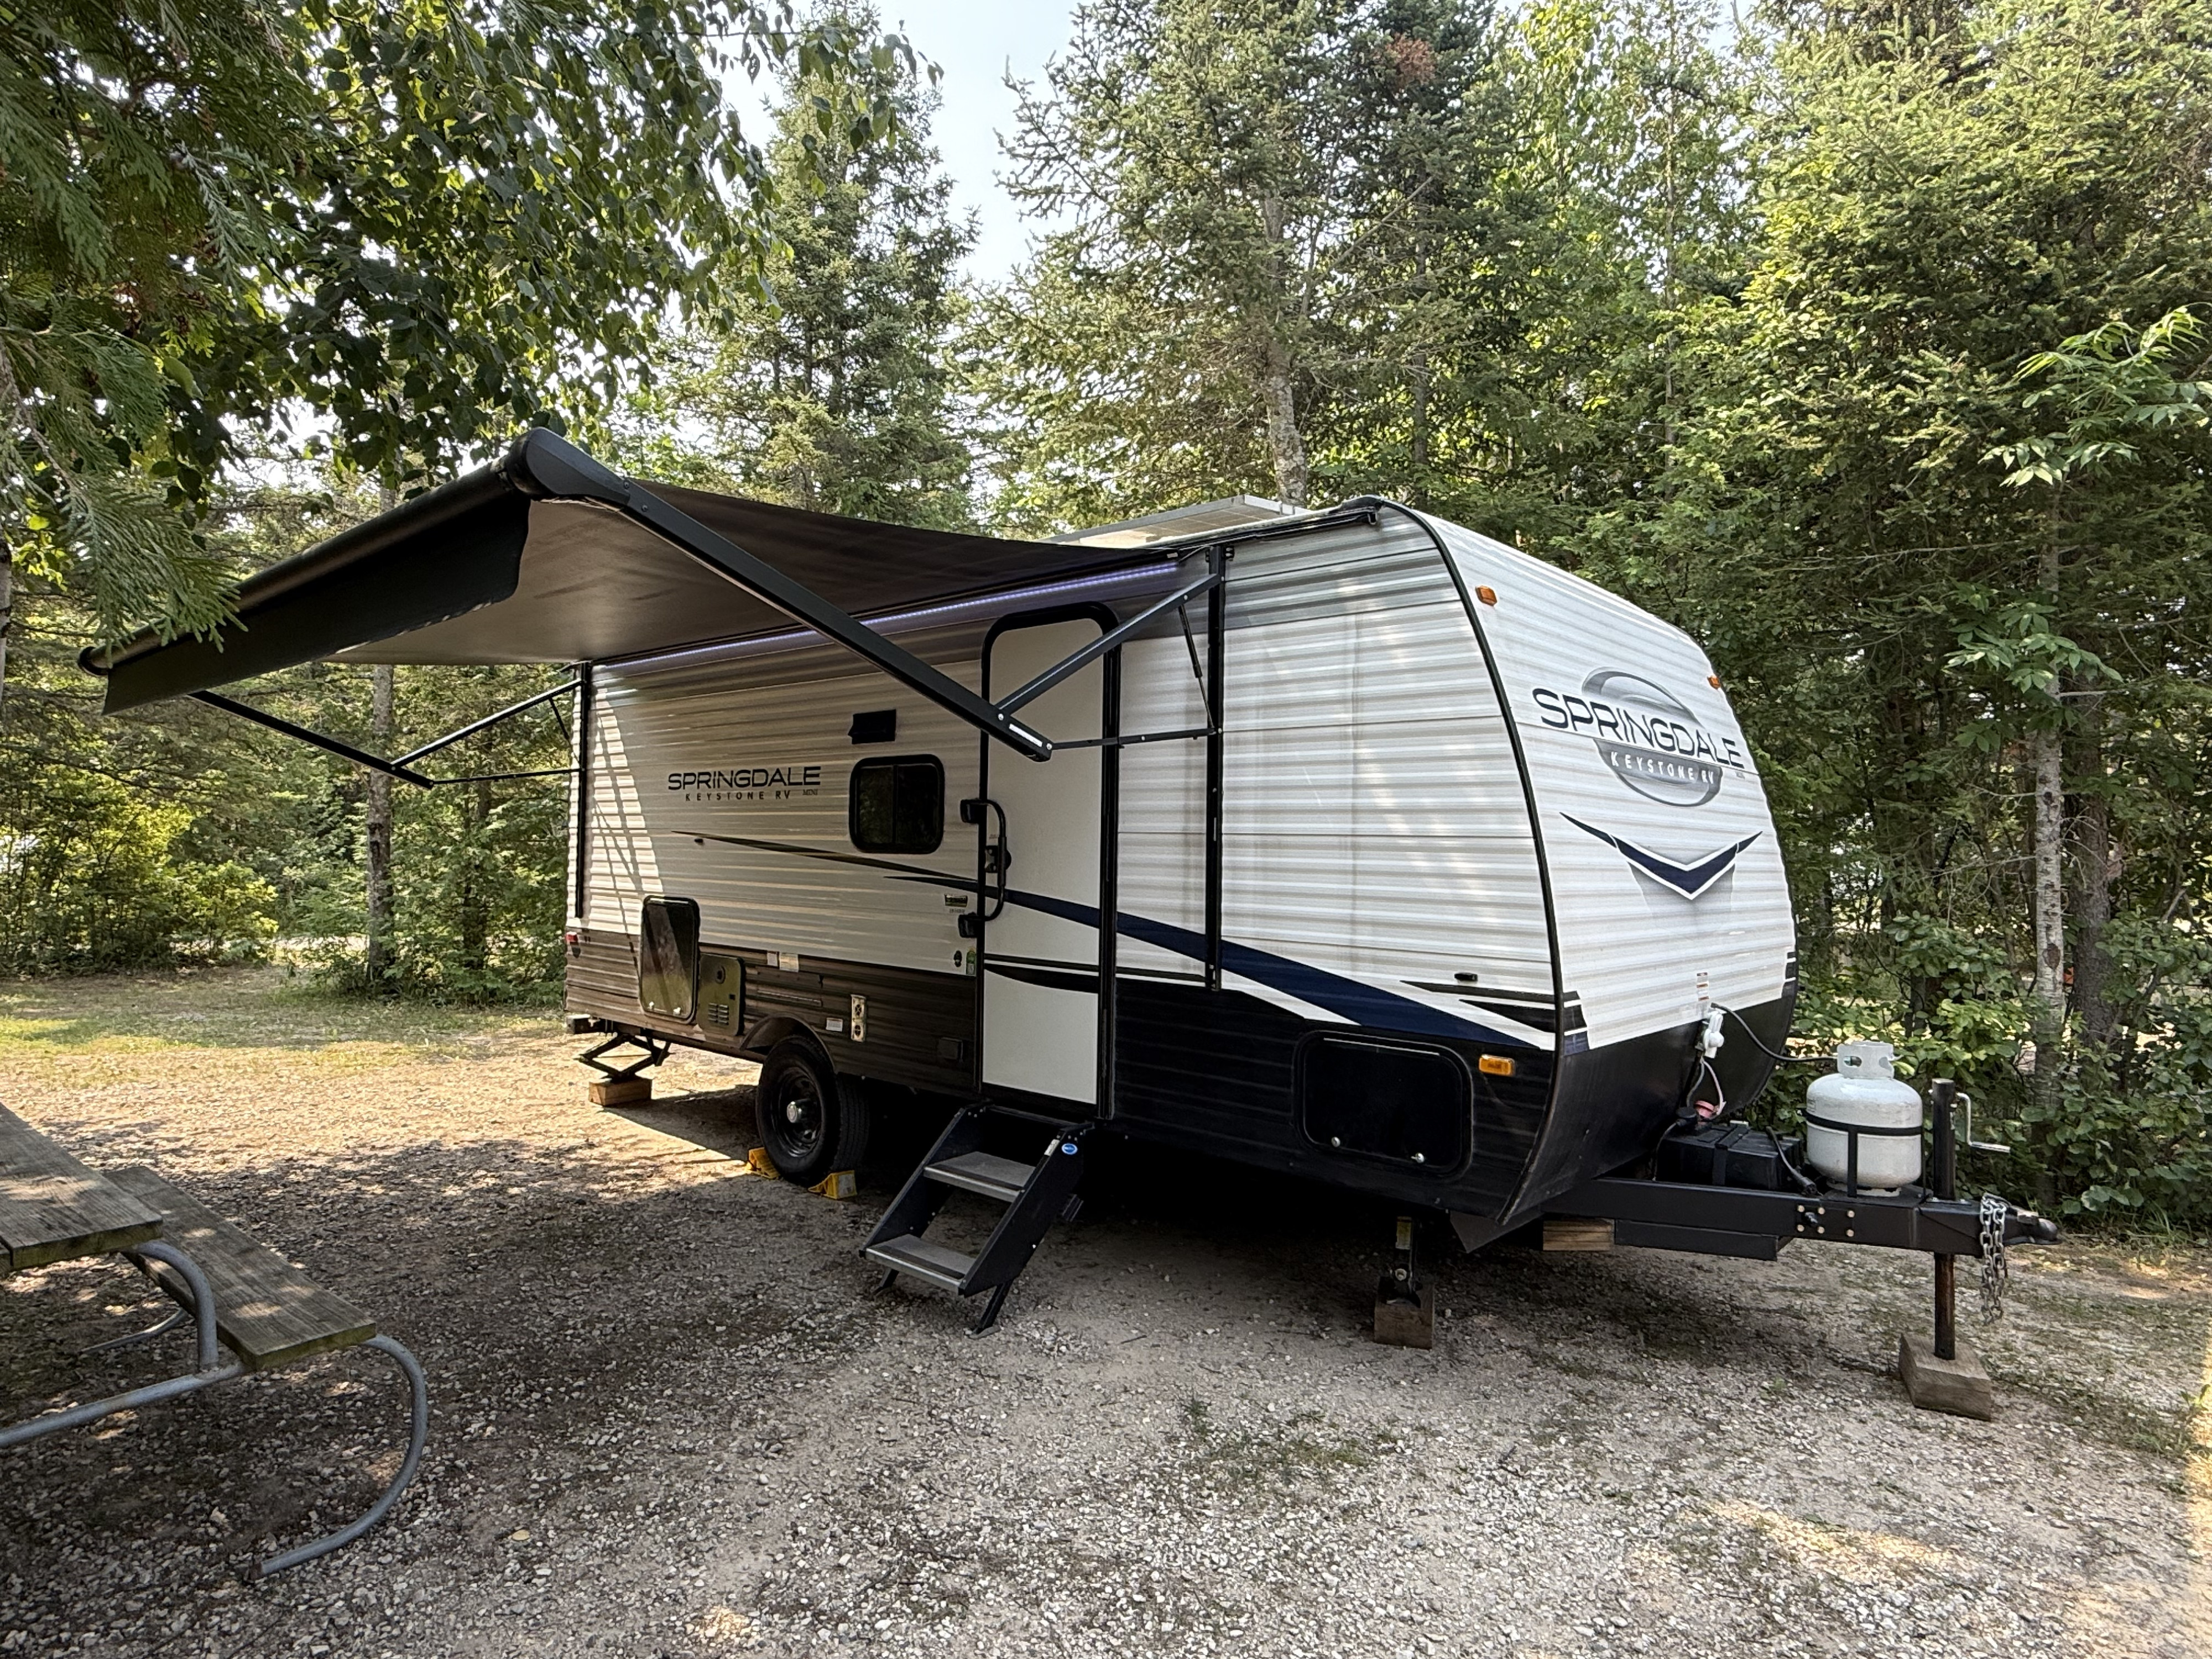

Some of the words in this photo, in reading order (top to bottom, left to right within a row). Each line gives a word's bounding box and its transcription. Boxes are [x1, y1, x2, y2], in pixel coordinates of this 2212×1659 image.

[1532, 688, 1745, 769] SPRINGDALE
[668, 766, 821, 790] SPRINGDALE
[1611, 751, 1694, 780] KEYSTONE
[1702, 770, 1714, 784] RV
[685, 791, 764, 801] KEYSTONE
[775, 790, 790, 800] RV
